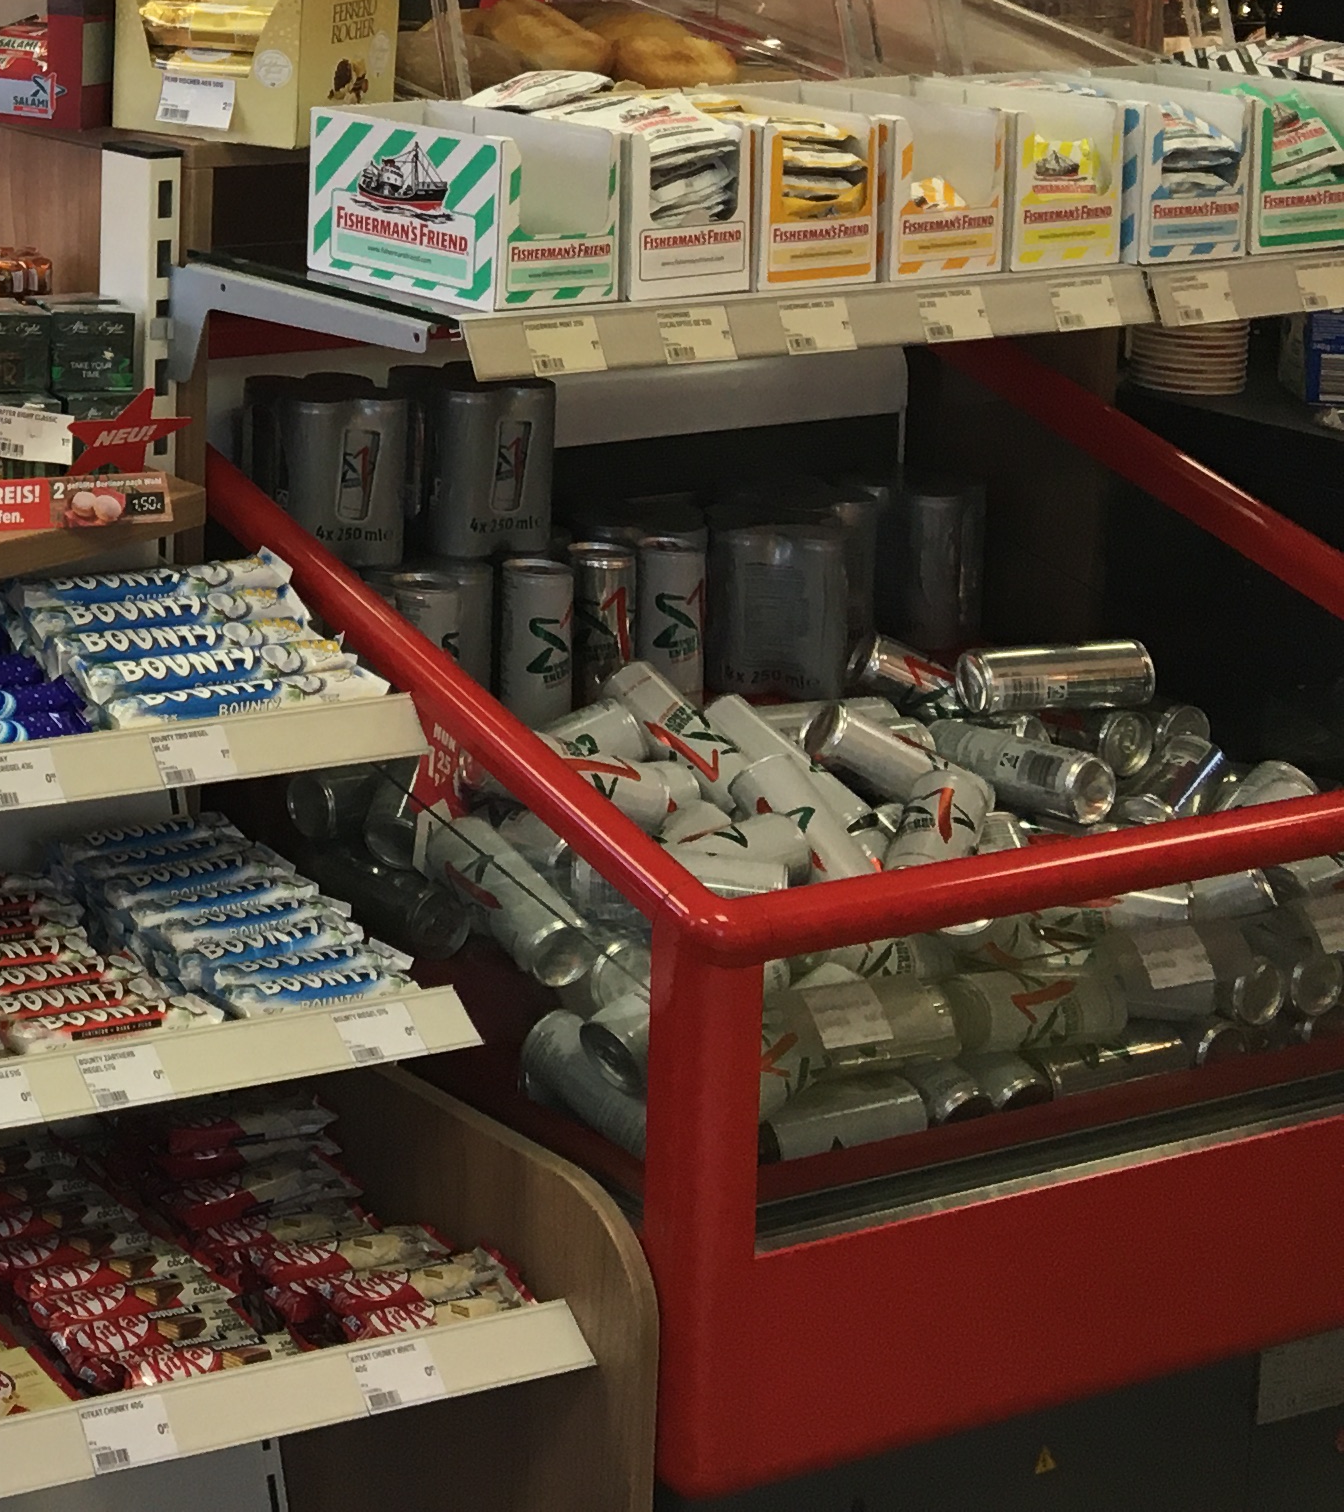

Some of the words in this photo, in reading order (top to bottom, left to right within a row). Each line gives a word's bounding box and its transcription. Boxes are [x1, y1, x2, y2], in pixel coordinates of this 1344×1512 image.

[331, 18, 376, 44] ROCHER
[419, 223, 469, 253] FRIEND
[93, 423, 156, 448] NEU!
[115, 646, 253, 683] BOUNTY
